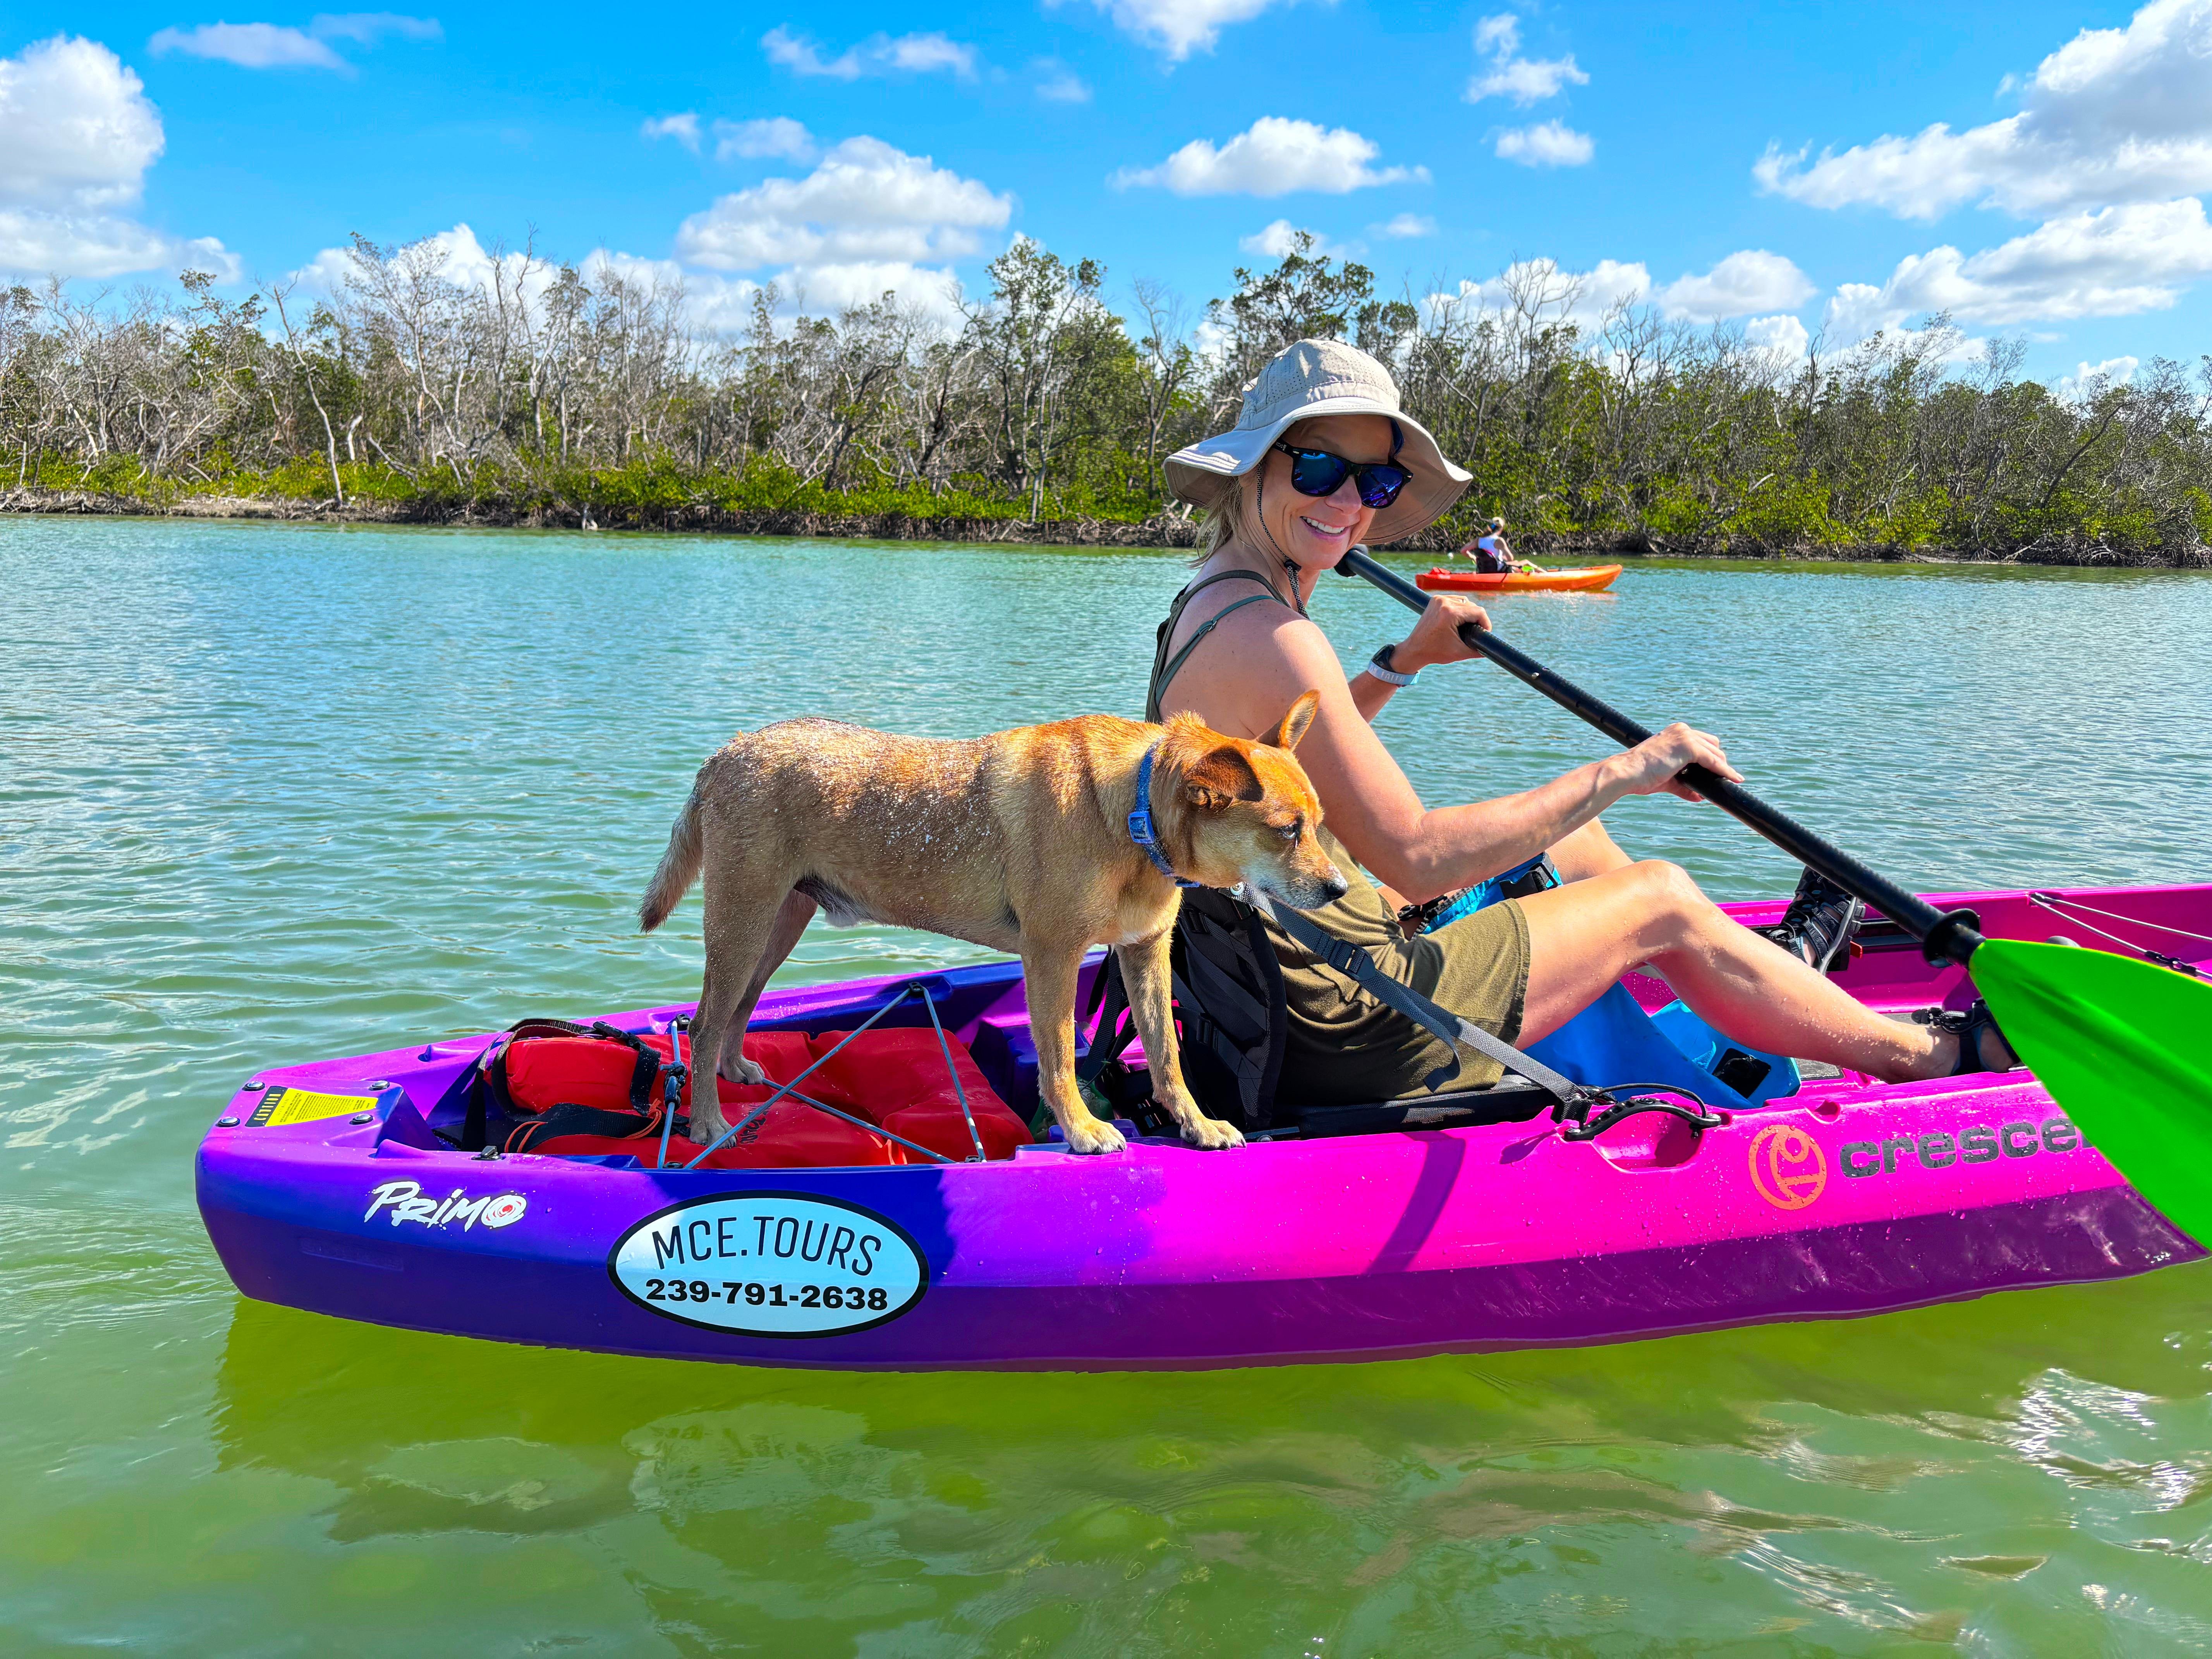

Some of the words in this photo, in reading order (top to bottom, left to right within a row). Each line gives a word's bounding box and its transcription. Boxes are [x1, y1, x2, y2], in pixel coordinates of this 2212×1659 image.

[1839, 1118, 2093, 1178] cresce
[652, 1216, 881, 1276] MCE.TOURS
[646, 1279, 888, 1310] 239-791-2638
